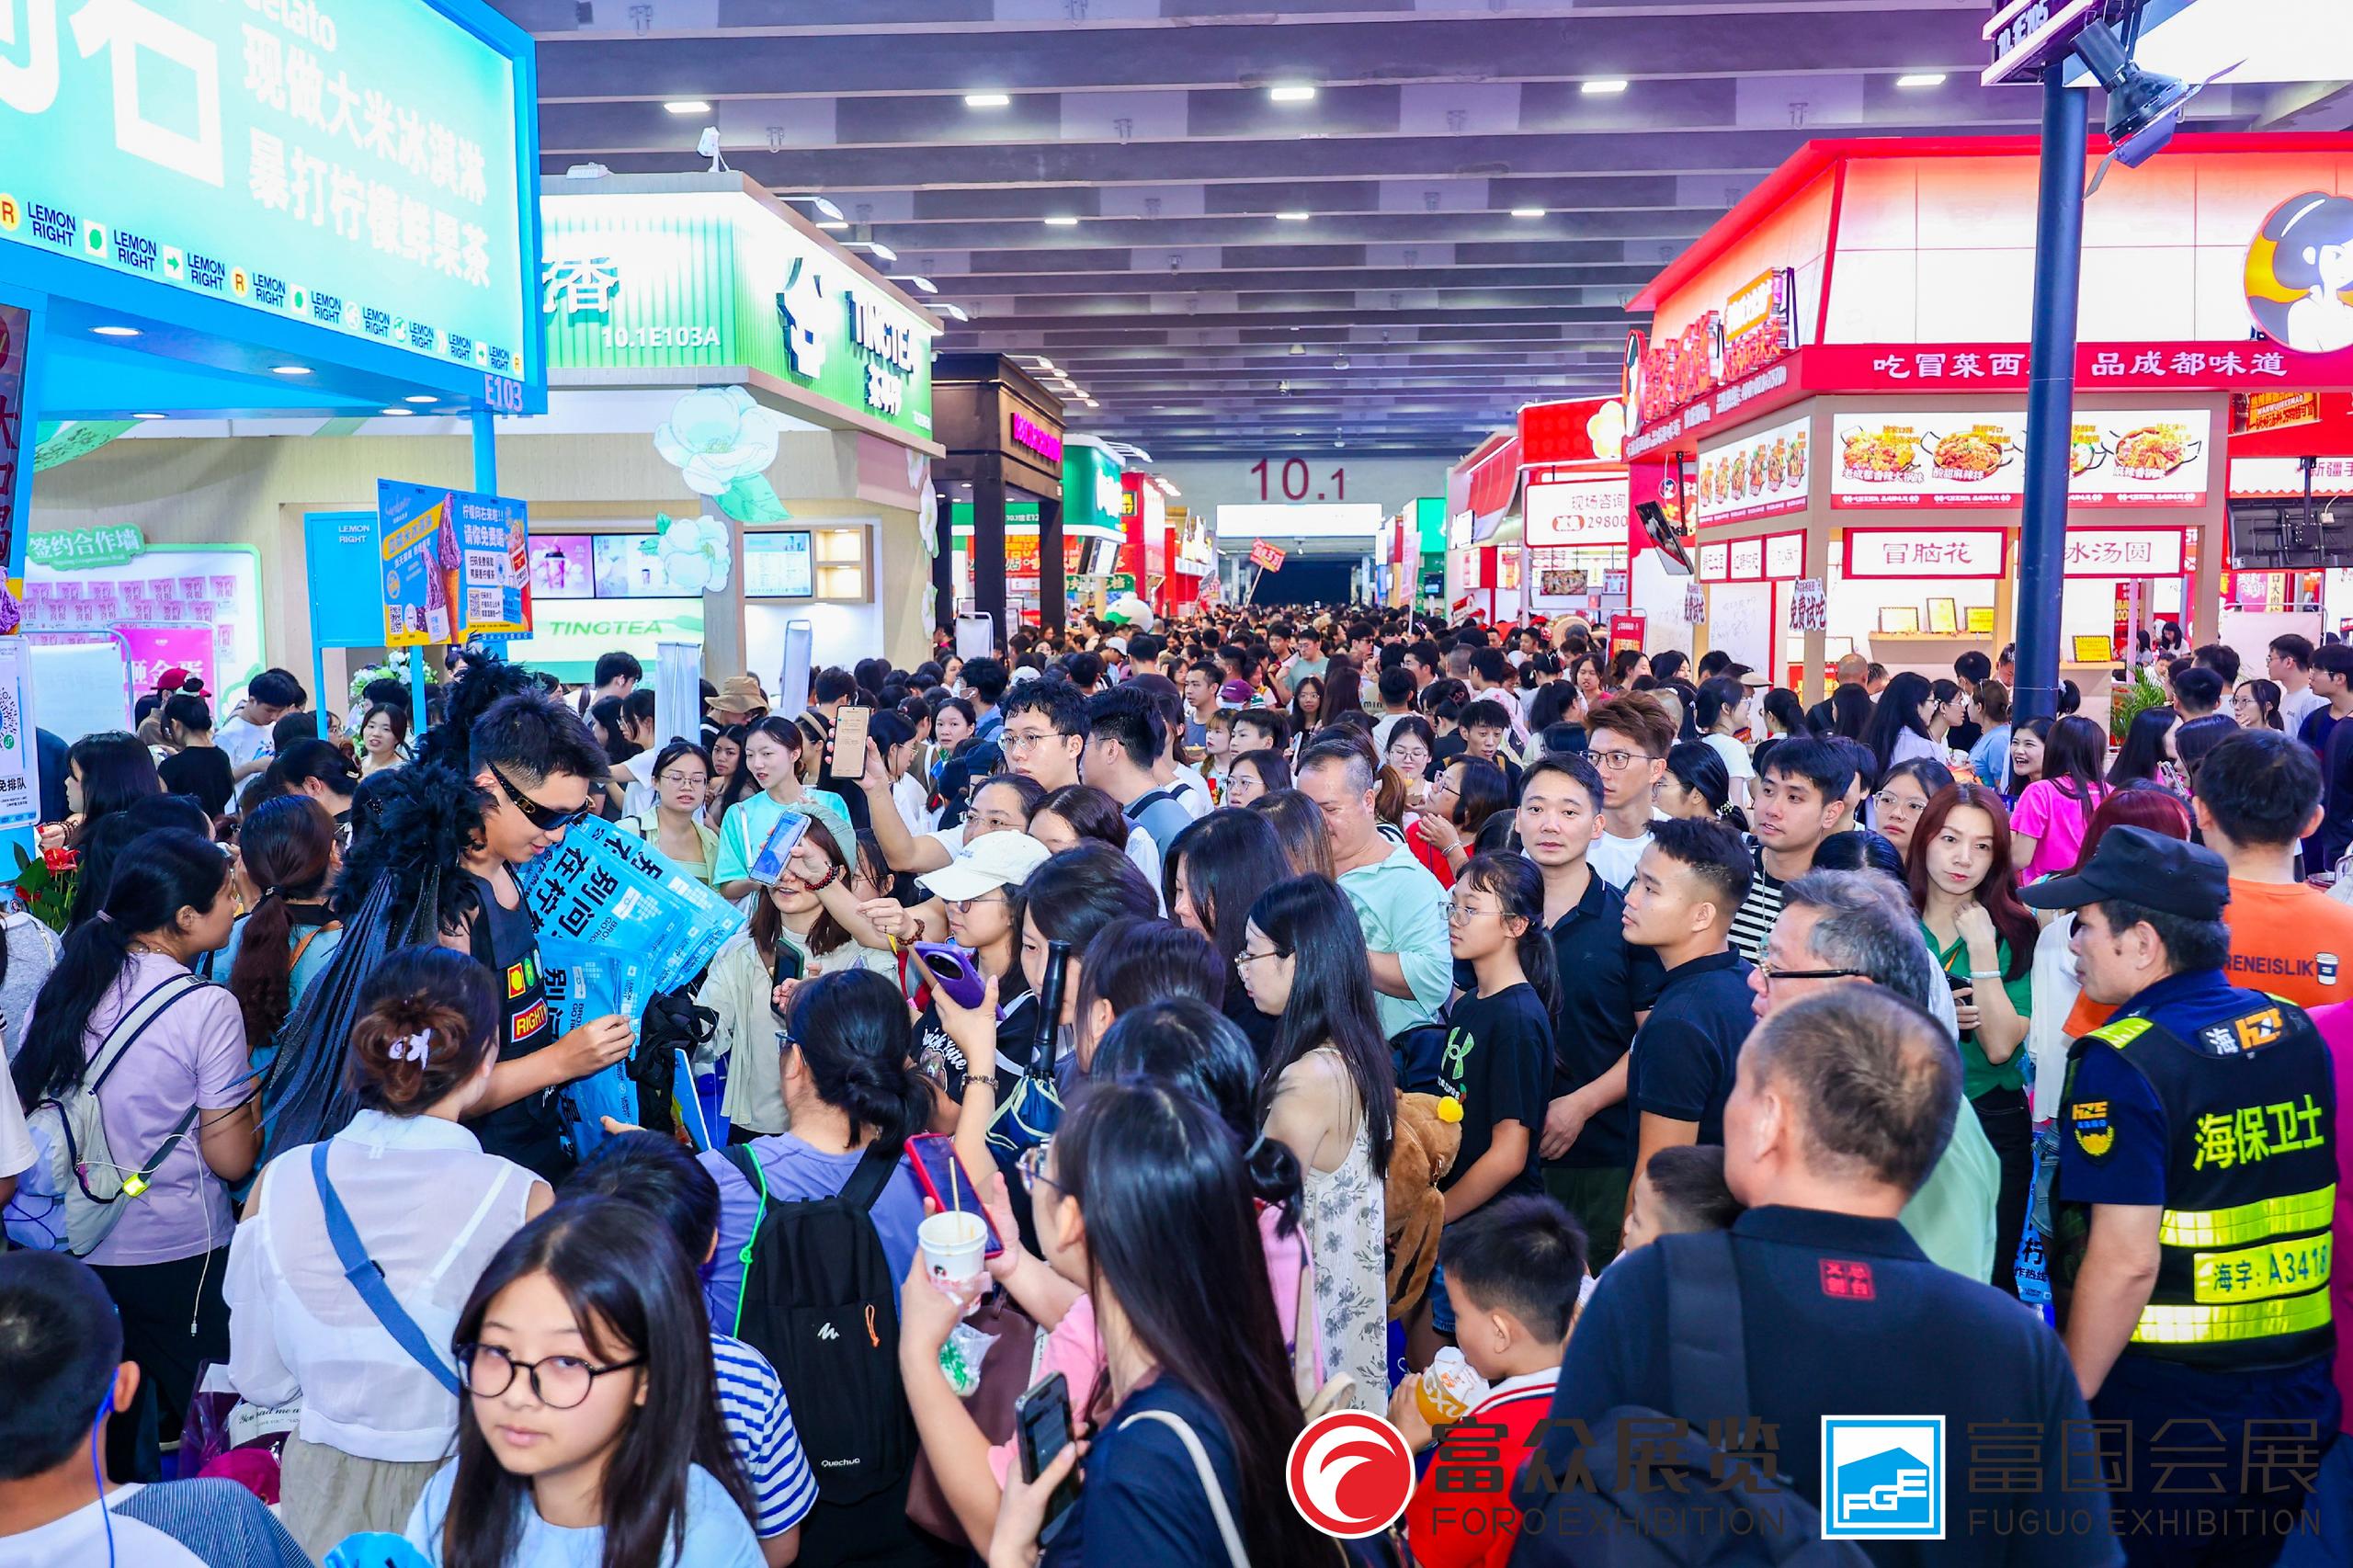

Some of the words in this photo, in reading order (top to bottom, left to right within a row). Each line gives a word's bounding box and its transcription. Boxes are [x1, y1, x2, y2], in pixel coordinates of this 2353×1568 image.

[239, 0, 337, 52] elato
[241, 22, 487, 206] 现做大米冰淇淋
[2, 200, 15, 224] R
[28, 201, 76, 232] LEMON
[248, 125, 491, 290] 暴打柠檬鲜果茶
[32, 221, 74, 247] RIGHT
[113, 229, 157, 257] LEMON
[118, 247, 155, 272] RIGHT
[187, 252, 226, 277] LEMON
[191, 269, 224, 290] RIGHT
[234, 273, 244, 291] R
[252, 273, 286, 294] LEMON
[256, 288, 285, 308] RIGHT
[311, 290, 341, 312] LEMON
[313, 305, 340, 324] RIGHT
[363, 307, 391, 325] LEMON
[365, 320, 389, 338] RIGHT
[409, 322, 434, 339] LEMON
[601, 327, 722, 348] 10.1E103A
[412, 334, 434, 350] RIGHT
[449, 333, 472, 350] LEMON
[450, 344, 471, 361] RIGHT
[489, 346, 510, 361] LEMON
[491, 357, 509, 372] RIGHT
[1872, 353, 2030, 380] 吃冒菜西
[2091, 350, 2288, 377] 品成都味道
[483, 374, 524, 412] E103
[1250, 458, 1345, 501] 10.1
[1571, 494, 1626, 511] 现场咨询
[338, 525, 370, 533] LEMON
[339, 535, 367, 543] RIGHT
[463, 524, 506, 548] 请你免费喝
[28, 528, 141, 558] 签约合作墙
[1882, 542, 1974, 564] 冒脑花
[549, 620, 664, 636] TINGTEA
[601, 921, 619, 941] BRO!
[517, 1003, 548, 1036] RIGHT
[2192, 1094, 2325, 1171] 海保卫士
[821, 1457, 861, 1469] Quechua
